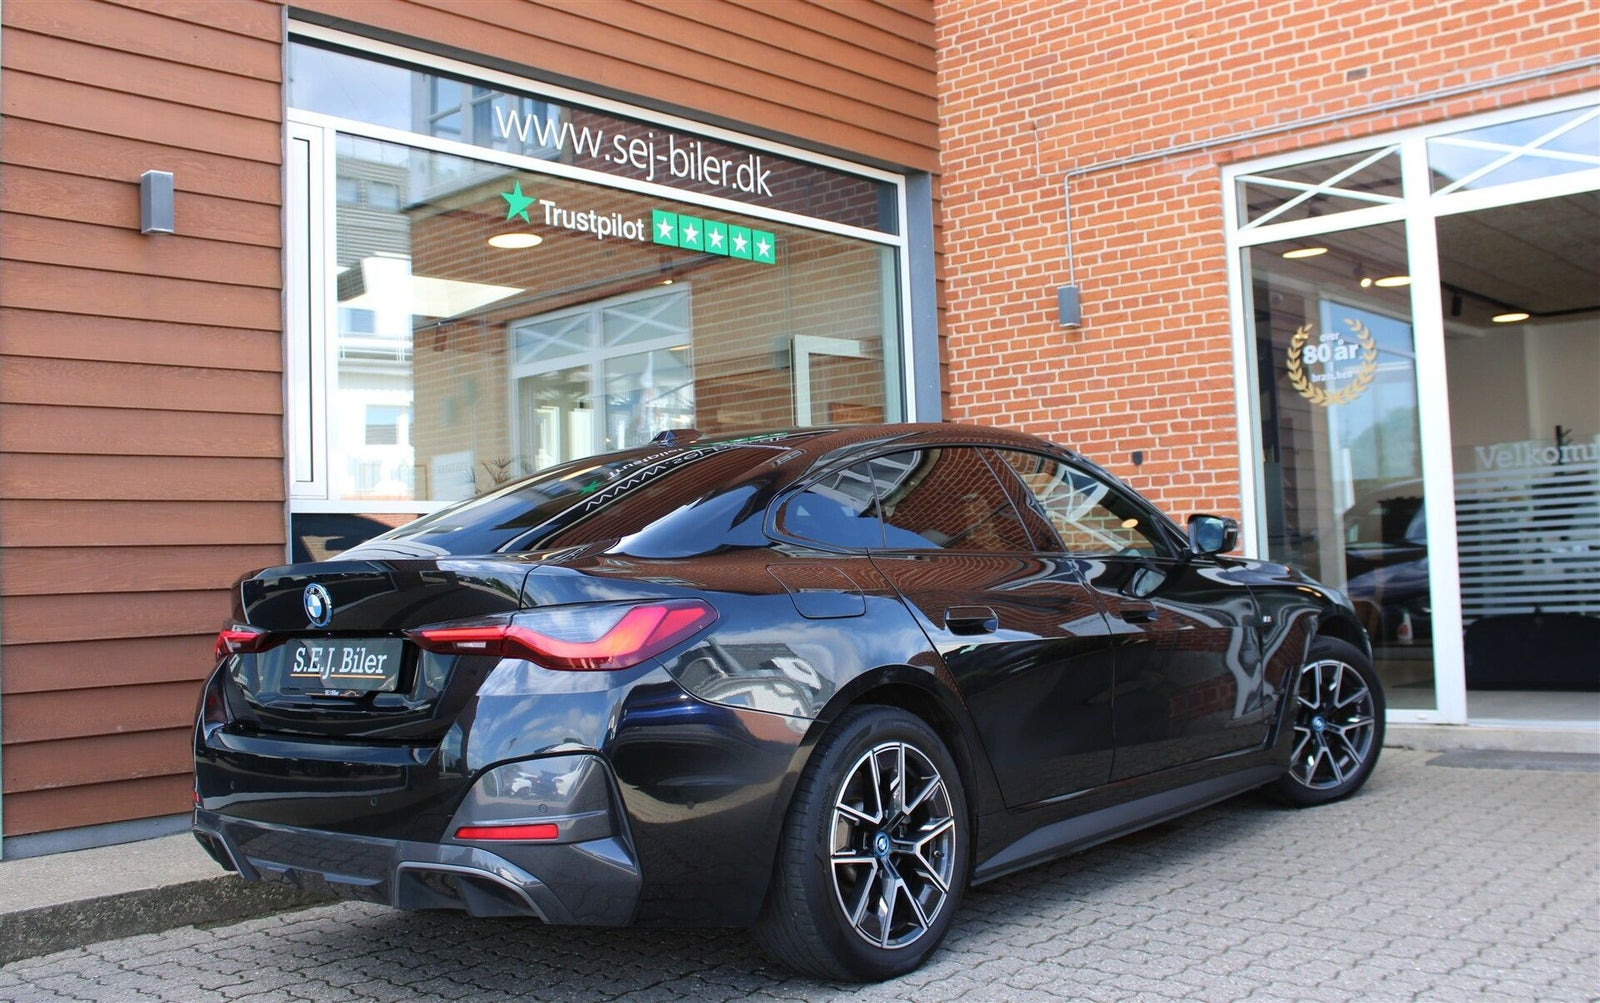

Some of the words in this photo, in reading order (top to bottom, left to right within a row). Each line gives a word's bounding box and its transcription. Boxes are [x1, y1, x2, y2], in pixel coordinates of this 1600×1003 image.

[495, 105, 773, 198] www.sej-biler.dk
[539, 198, 645, 242] Trustpilot
[1302, 343, 1332, 365] 80
[1334, 338, 1359, 361] år
[293, 647, 335, 680] S.E.J.
[339, 647, 387, 674] Biler
